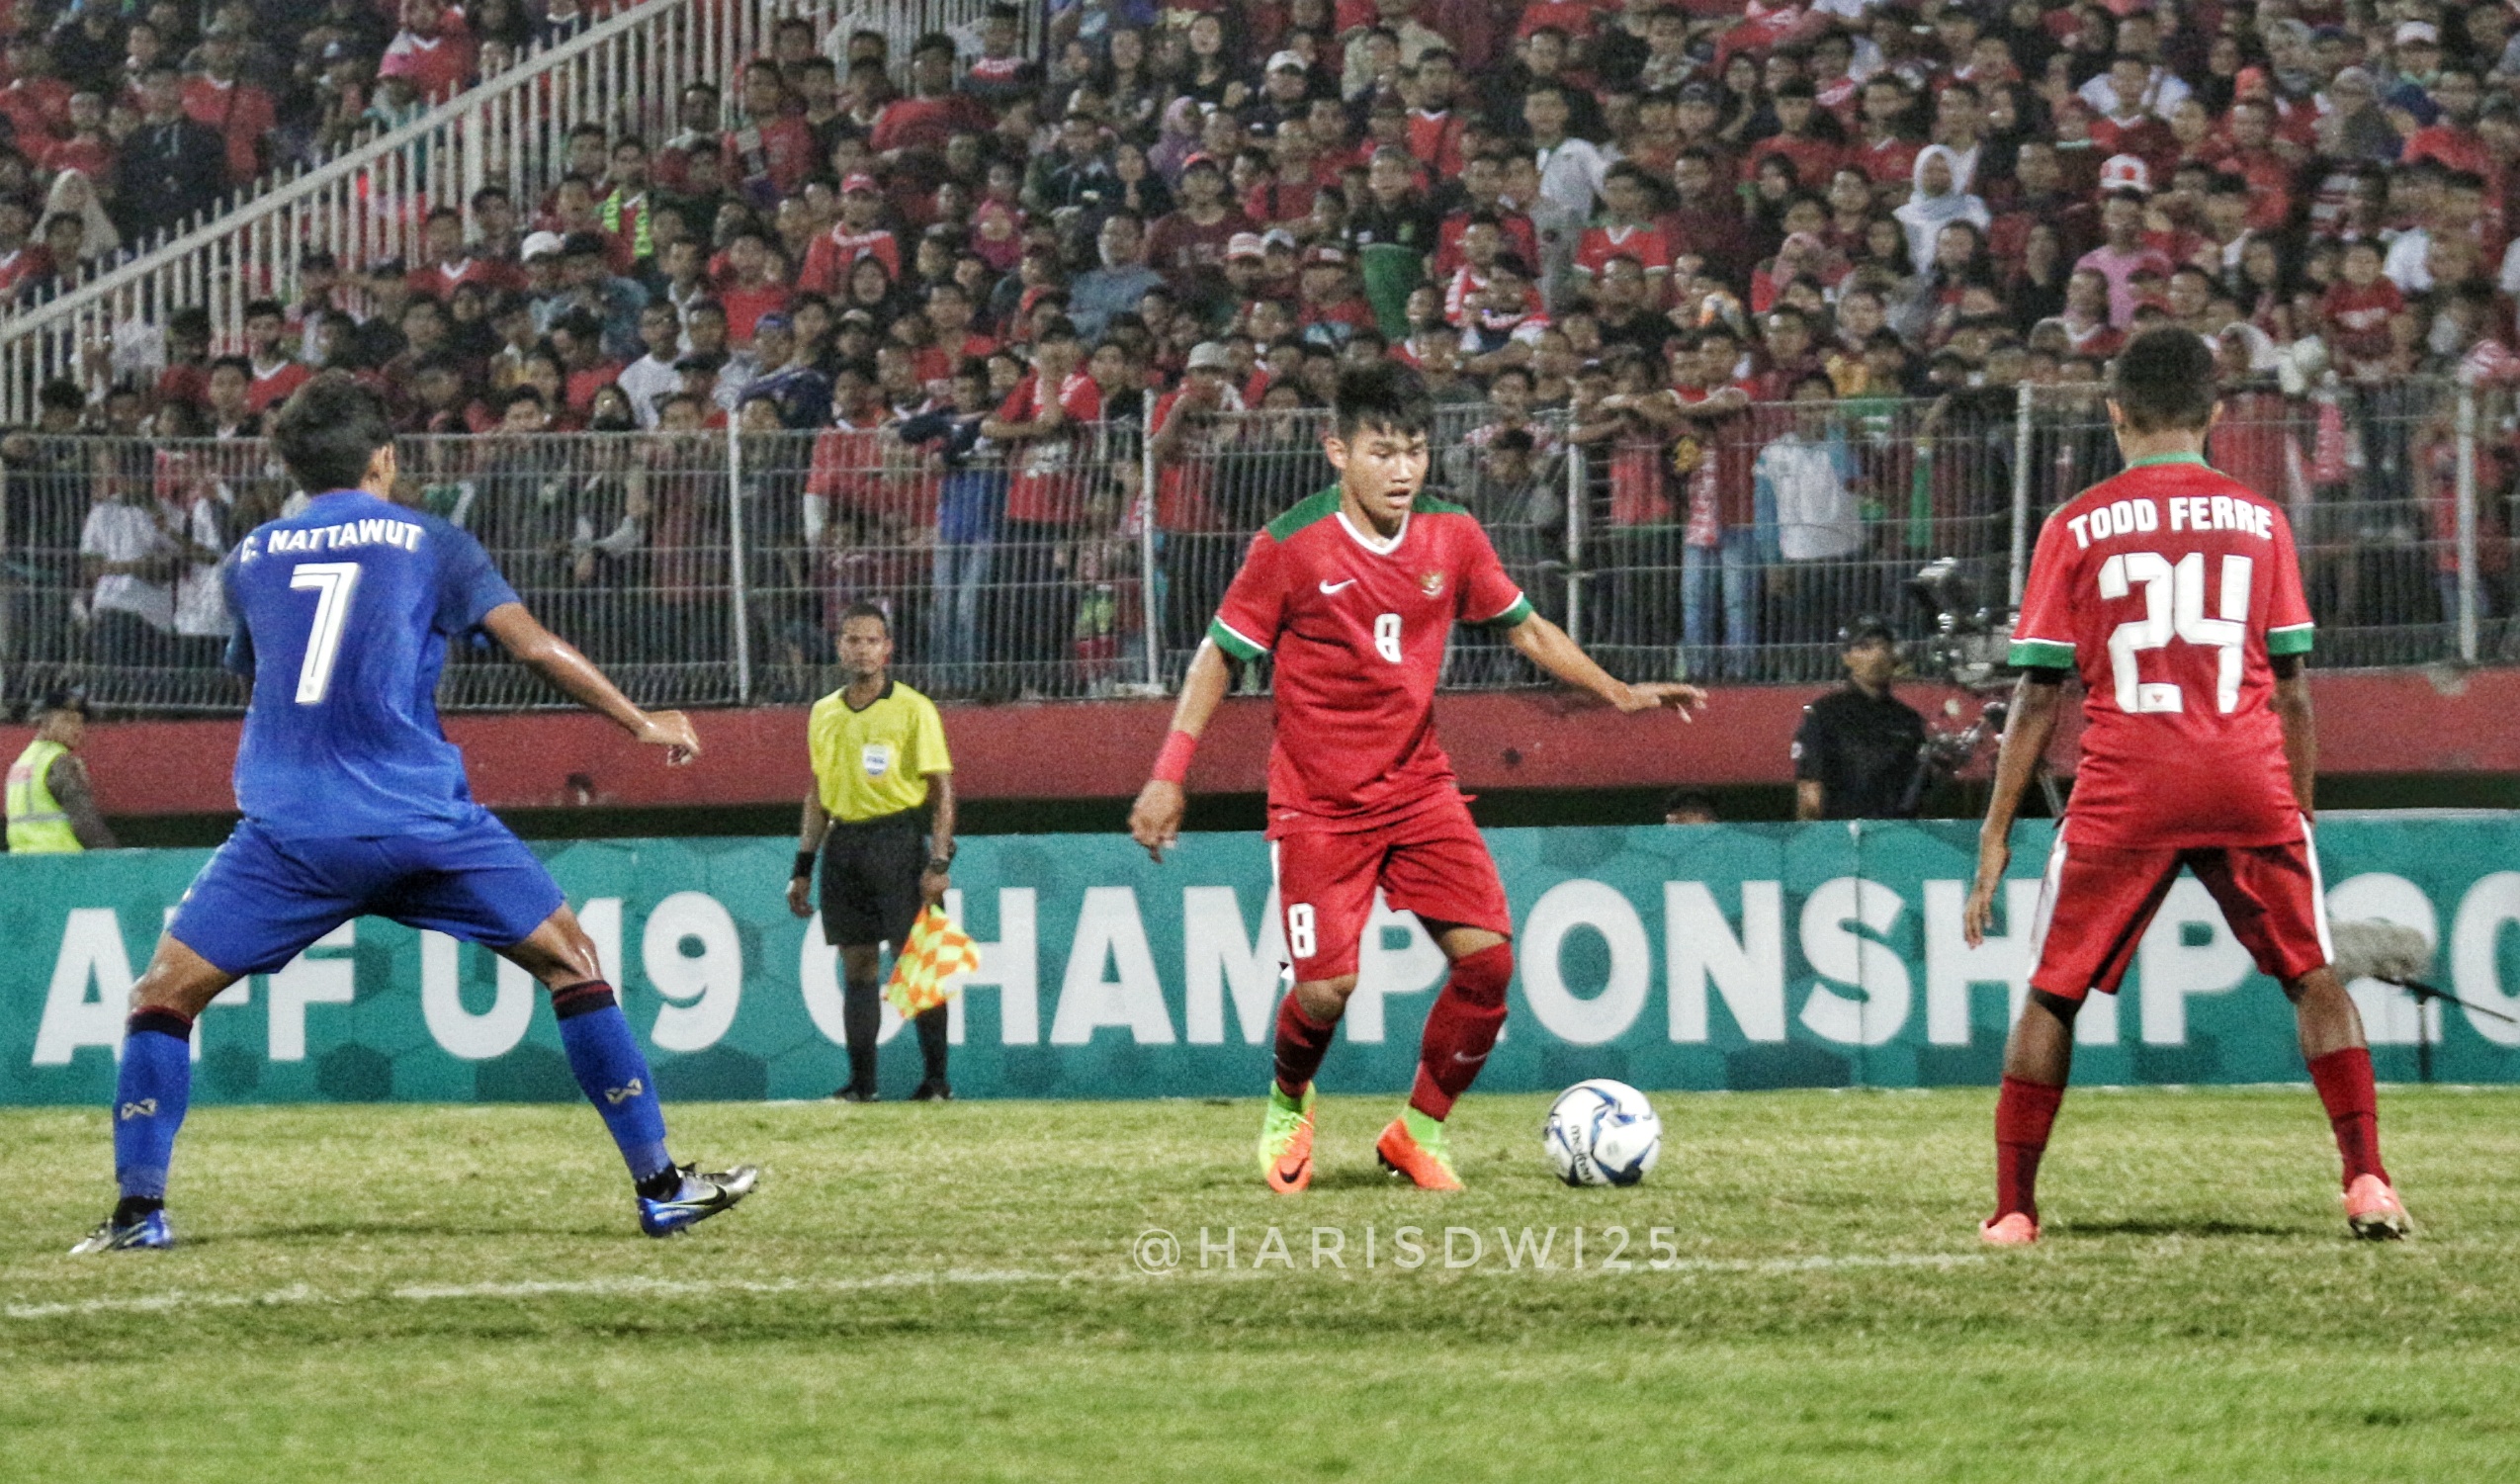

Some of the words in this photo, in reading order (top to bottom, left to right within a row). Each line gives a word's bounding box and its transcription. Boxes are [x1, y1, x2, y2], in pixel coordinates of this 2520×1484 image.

[268, 518, 422, 554] NATTAWUT
[2067, 498, 2158, 550] TODD
[2169, 495, 2273, 540] FERRE
[290, 562, 359, 704] 7
[1373, 612, 1403, 664] 8
[2098, 552, 2253, 714] 24
[1288, 902, 1317, 959] 8
[31, 908, 355, 1066] AF
[799, 874, 2256, 1048] CHAMPONSHP
